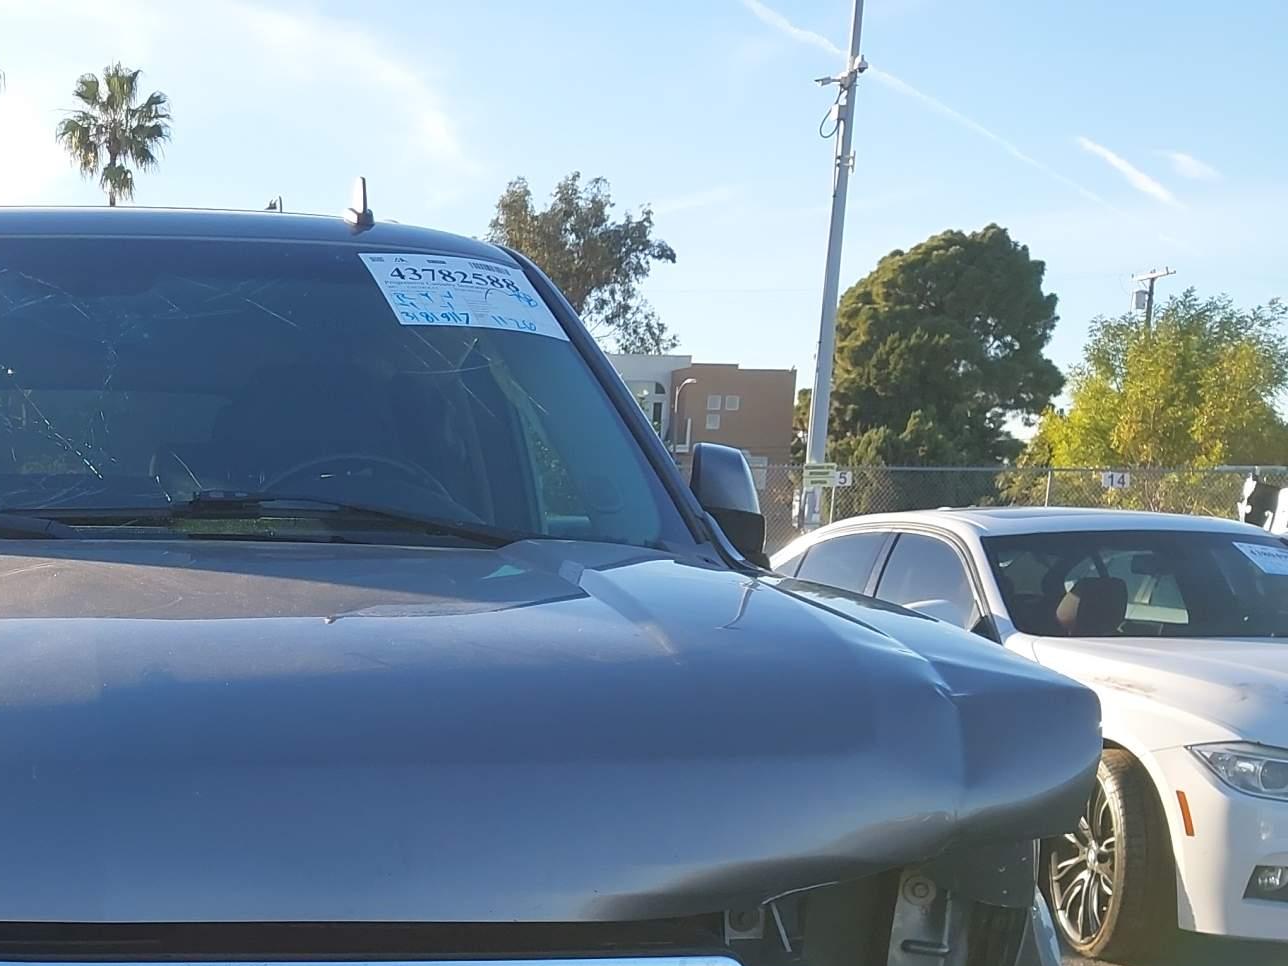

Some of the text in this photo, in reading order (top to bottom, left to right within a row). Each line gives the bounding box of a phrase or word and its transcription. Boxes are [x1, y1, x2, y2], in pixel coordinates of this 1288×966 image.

[390, 267, 519, 292] 43782588
[838, 472, 847, 485] 5
[1108, 473, 1126, 487] 14
